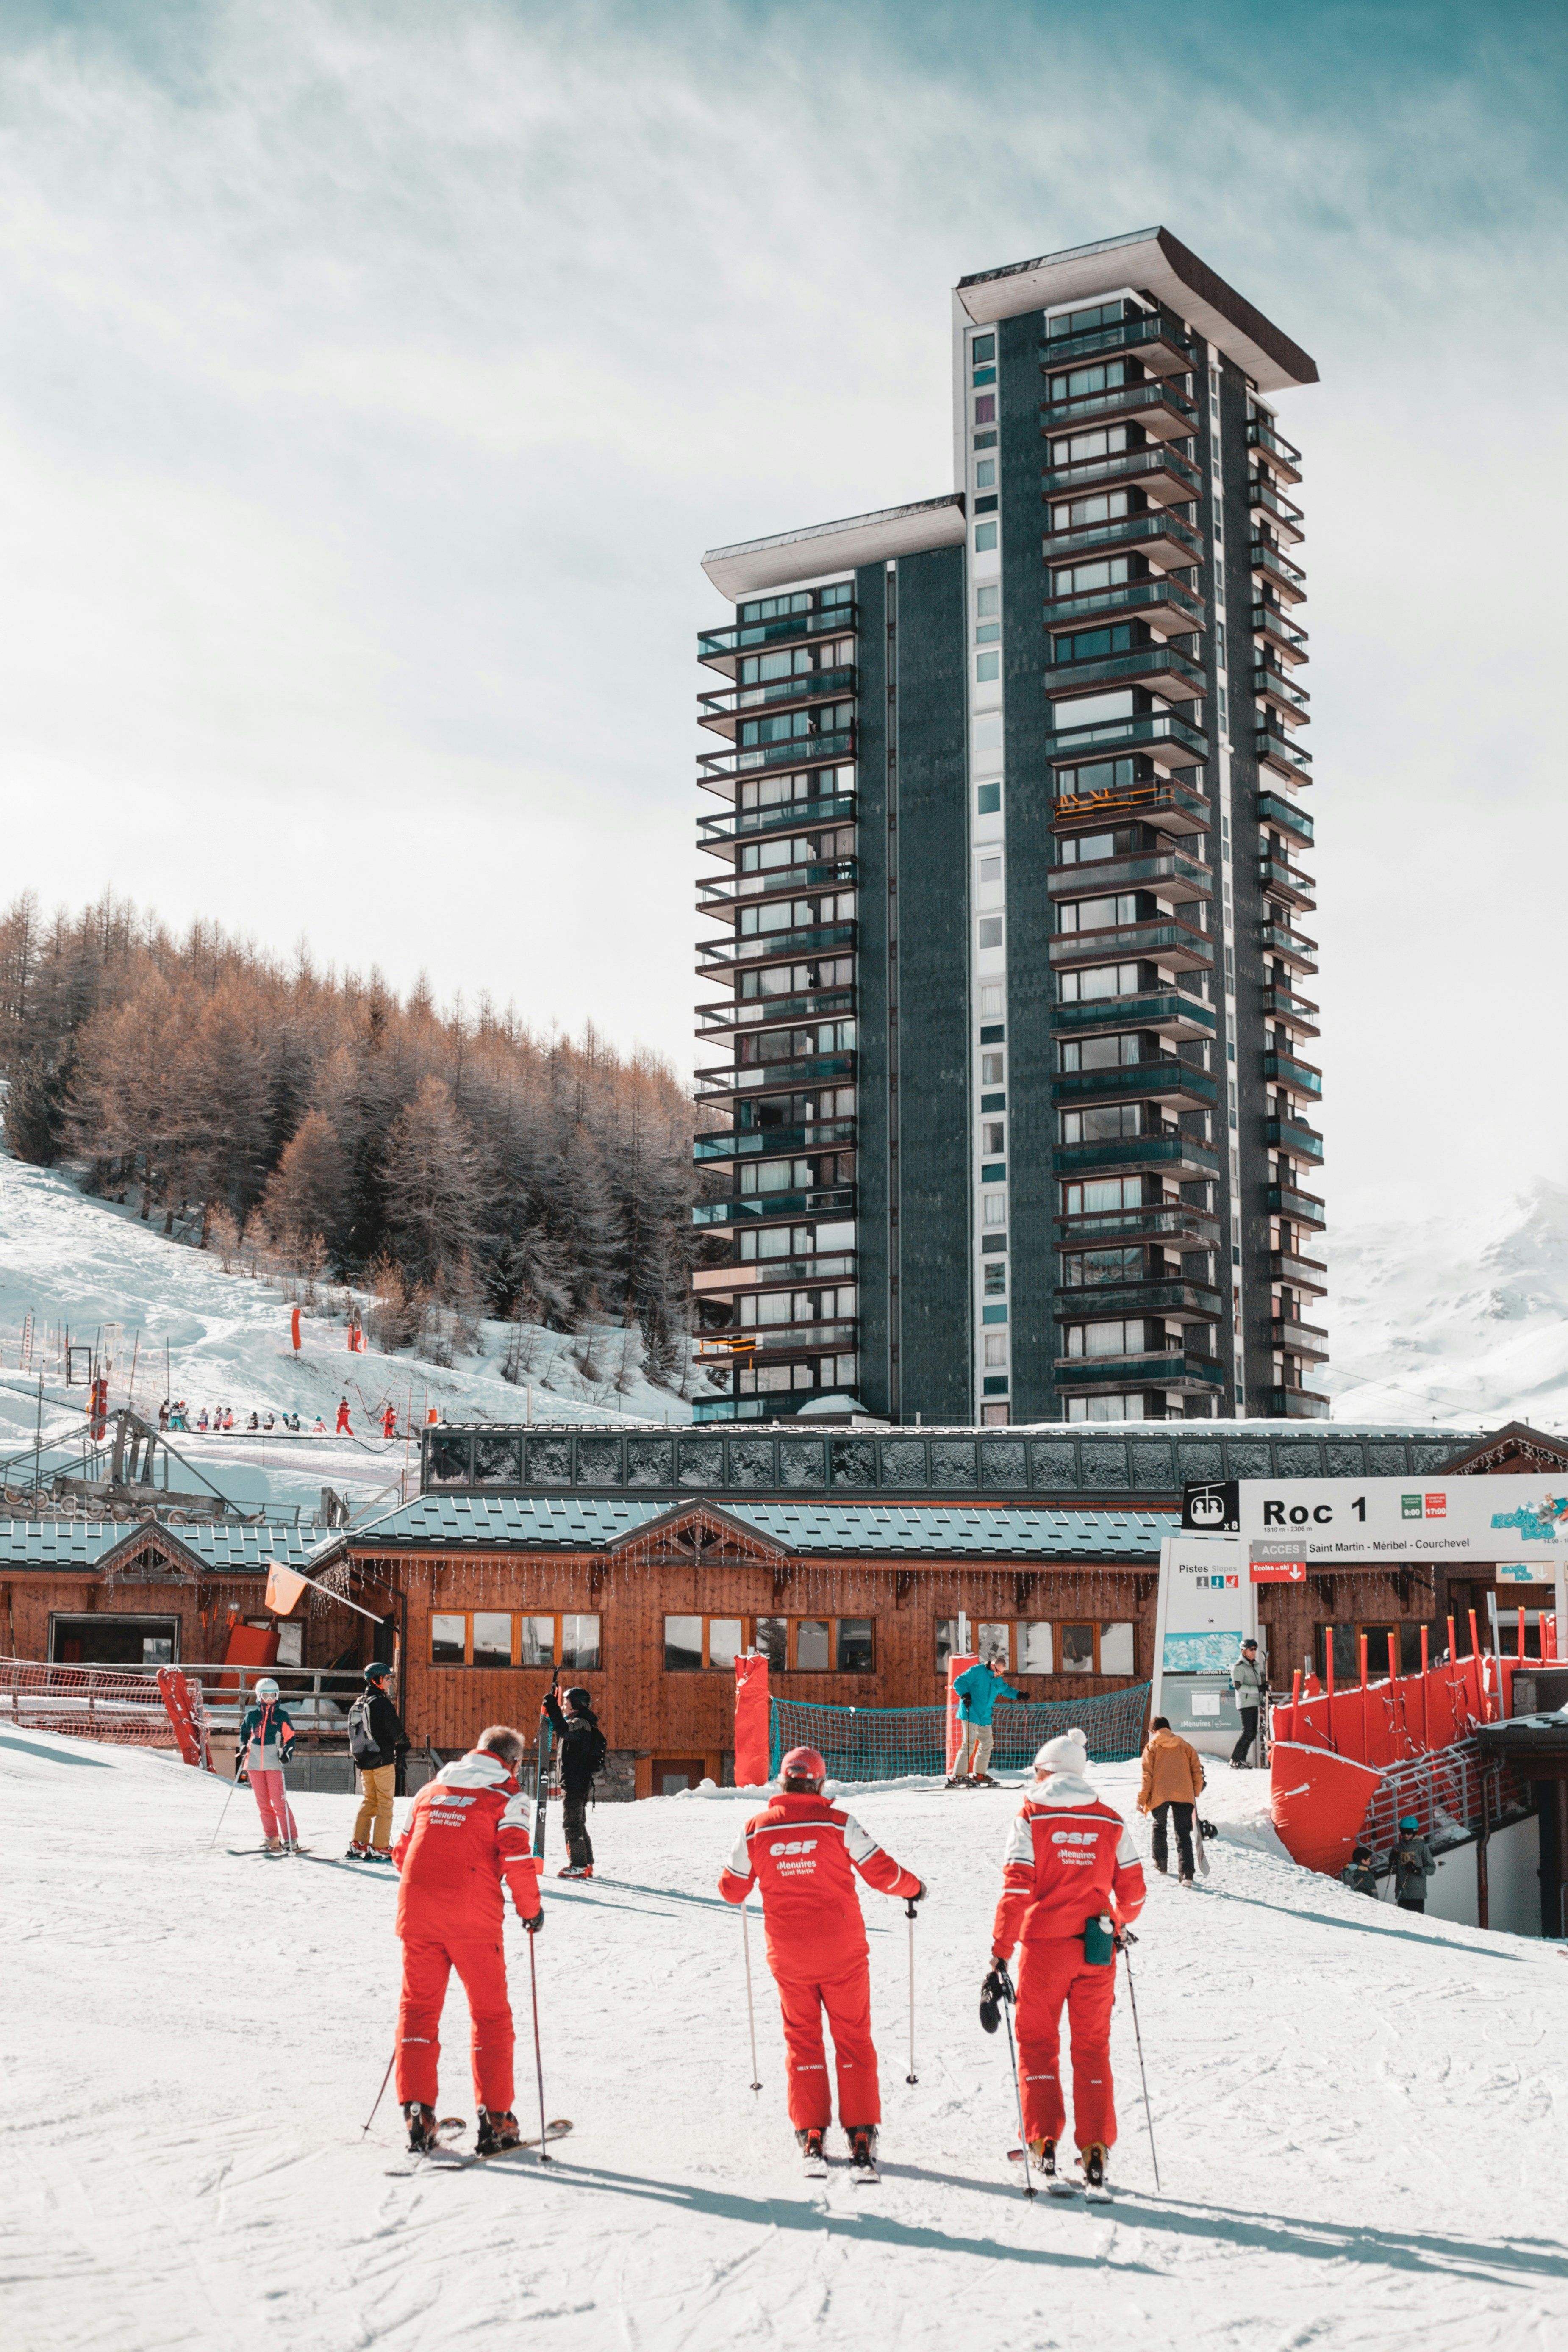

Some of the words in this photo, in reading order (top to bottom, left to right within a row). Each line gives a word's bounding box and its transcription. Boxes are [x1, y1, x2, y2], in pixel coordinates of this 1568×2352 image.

[1263, 1501, 1333, 1525] Roc
[1352, 1497, 1365, 1522] 1
[1231, 1521, 1238, 1530] 8
[1521, 1524, 1556, 1541] BOB
[1262, 1544, 1299, 1555] ACCES
[1309, 1543, 1333, 1553] Saint
[1335, 1542, 1364, 1551] Martin
[1373, 1540, 1407, 1550] Méribel
[1415, 1538, 1469, 1549] Courchevel
[1183, 1720, 1211, 1728] Menuires
[432, 1809, 466, 1822] Menuires
[444, 1819, 461, 1828] Martin
[1060, 1849, 1096, 1859] Menuires
[779, 1858, 816, 1870] Menuires
